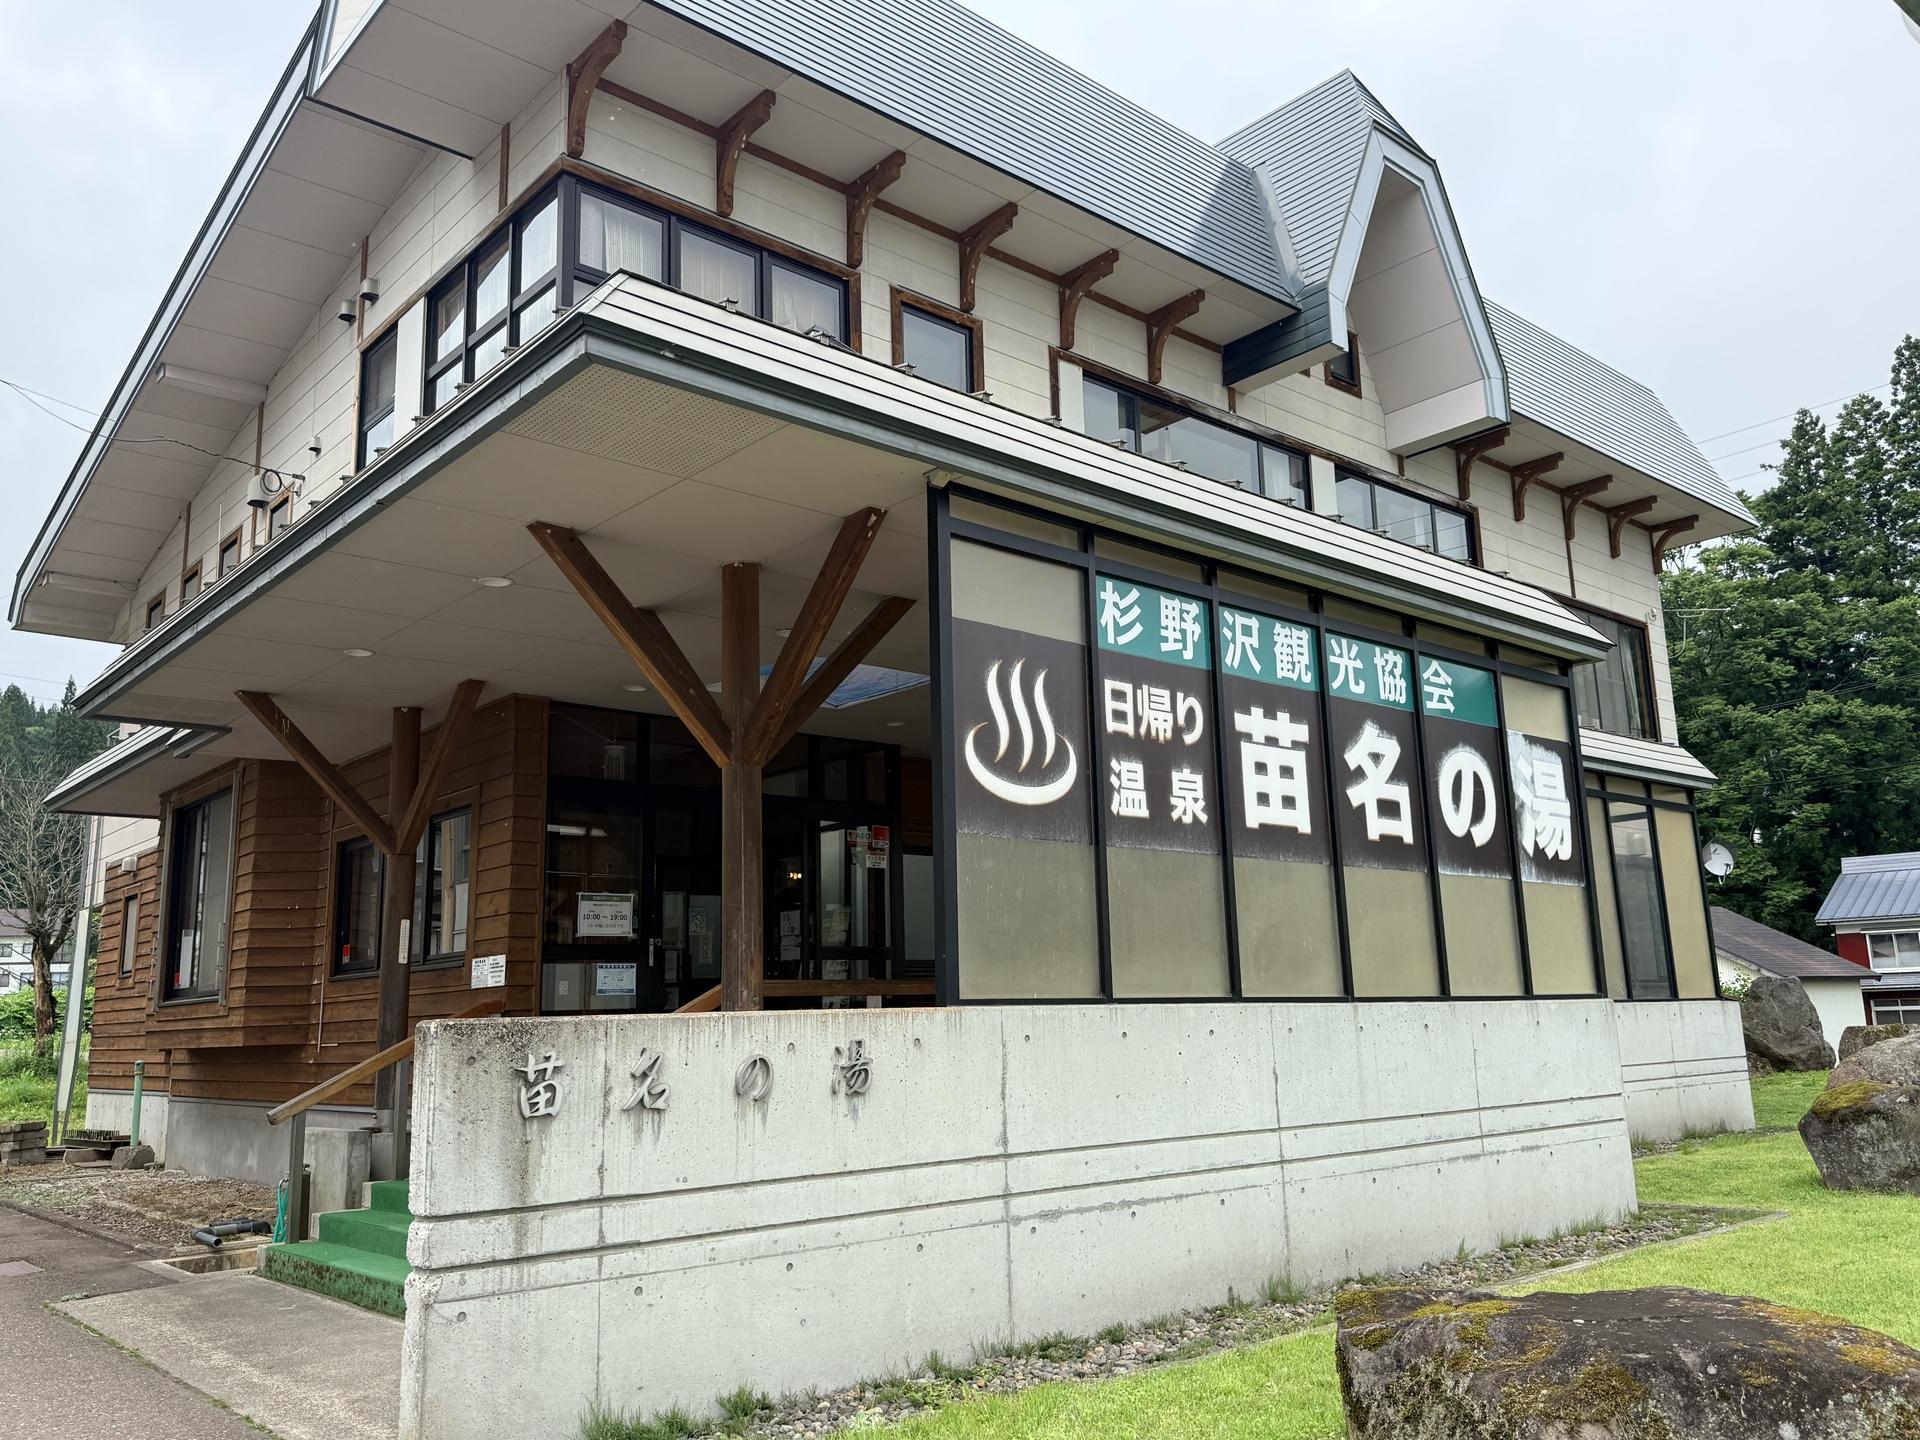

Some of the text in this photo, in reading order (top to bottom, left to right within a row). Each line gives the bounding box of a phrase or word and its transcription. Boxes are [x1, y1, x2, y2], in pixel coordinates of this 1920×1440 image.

[1100, 581, 1455, 713] 杉野沢観光協会
[1103, 678, 1205, 746] 日帰り
[1109, 757, 1208, 825] 温泉
[1234, 705, 1573, 862] 苗名の湯
[515, 1040, 875, 1120] 苗名の湯
